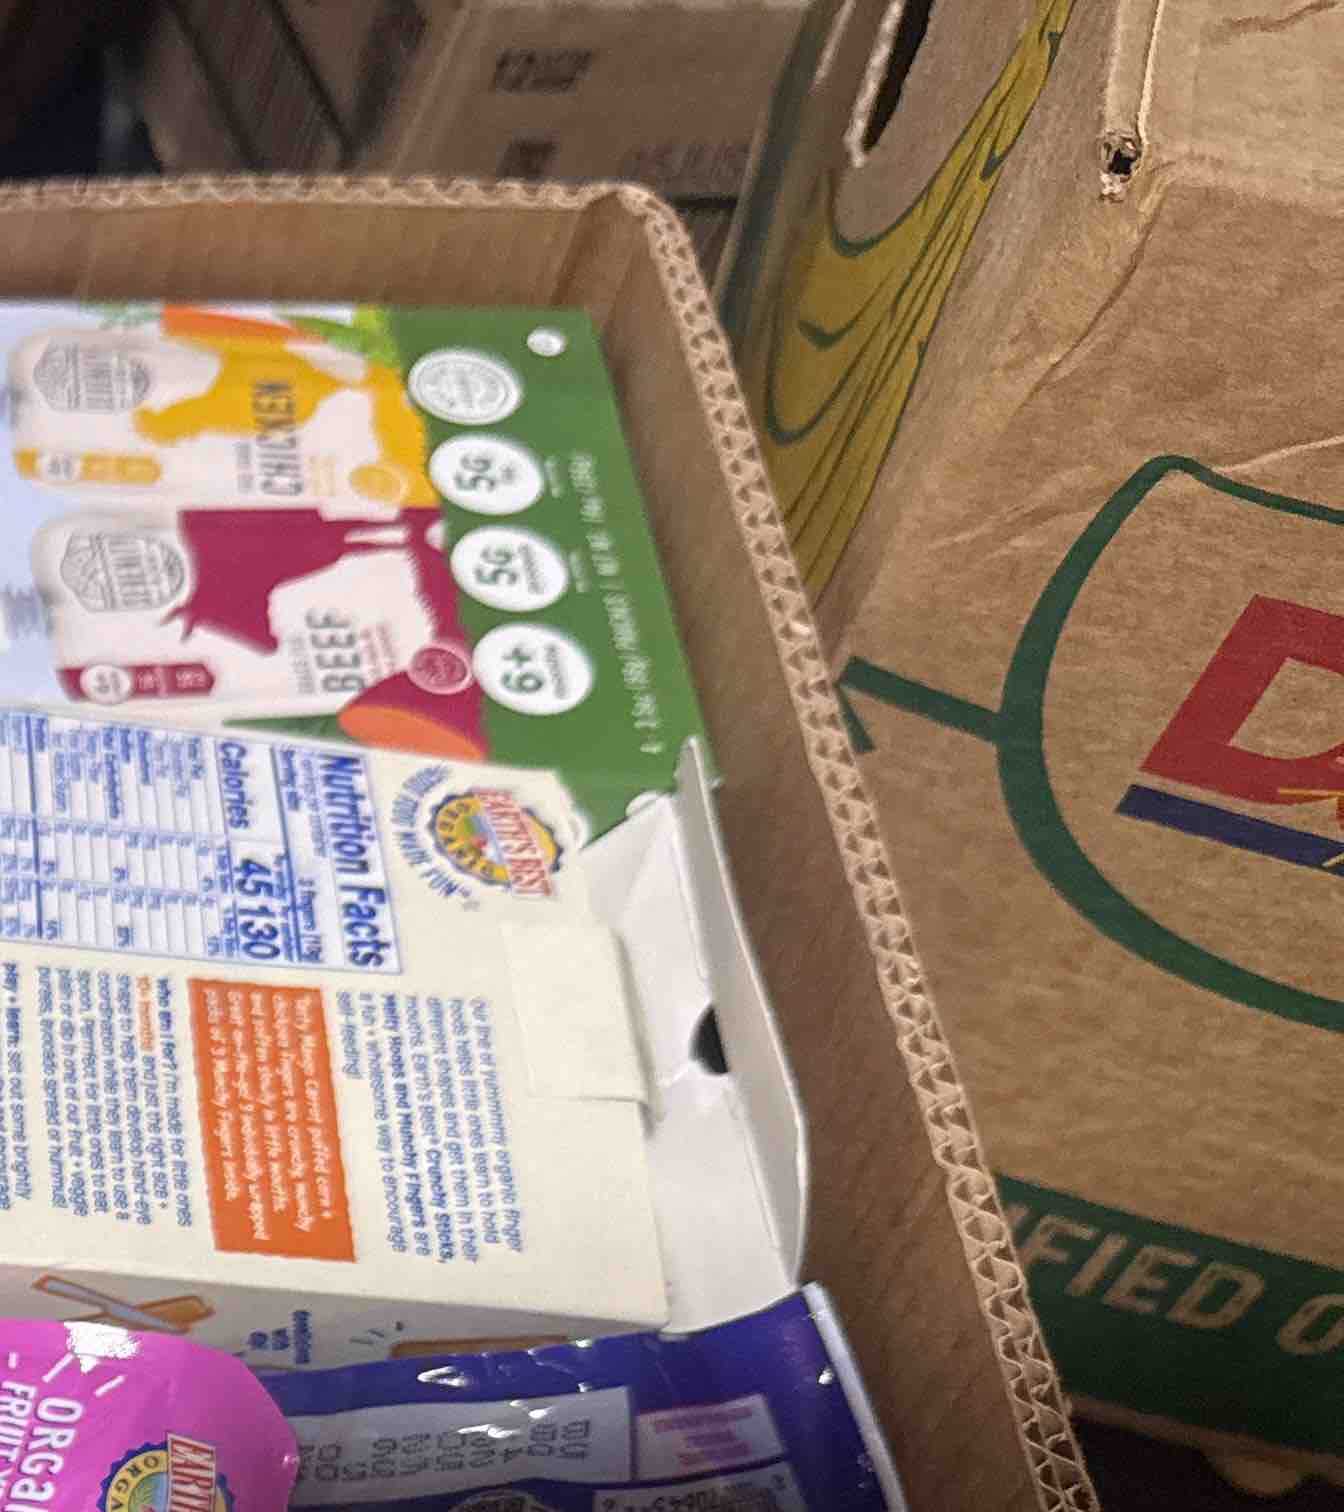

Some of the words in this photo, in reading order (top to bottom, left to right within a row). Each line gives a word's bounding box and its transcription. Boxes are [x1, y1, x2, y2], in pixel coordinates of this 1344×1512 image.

[306, 611, 366, 695] BEEF
[321, 752, 367, 876] Nutrition
[237, 854, 274, 897] 45
[240, 902, 280, 961] 130
[343, 878, 387, 969] Facts
[1009, 1206, 1265, 1328] FIED
